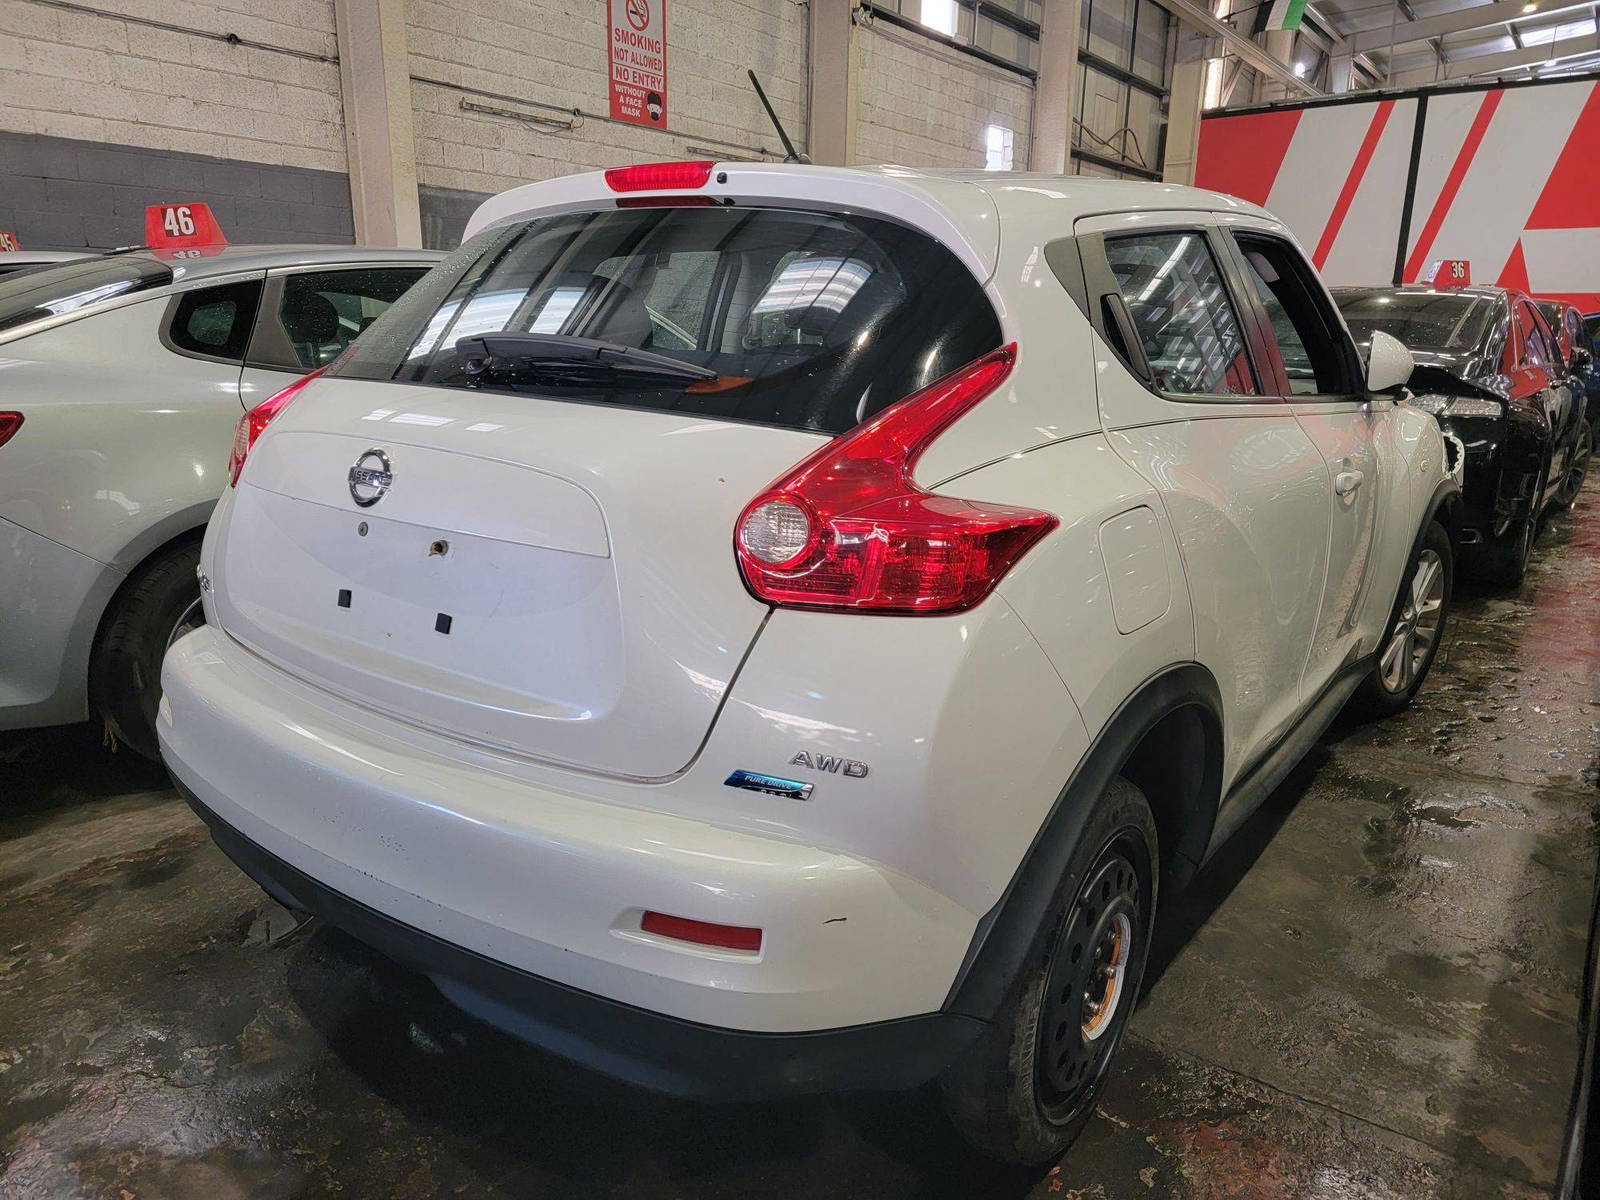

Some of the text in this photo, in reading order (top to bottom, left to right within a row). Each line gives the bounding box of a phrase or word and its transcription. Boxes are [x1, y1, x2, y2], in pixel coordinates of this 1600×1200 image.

[614, 27, 662, 54] SMOKING
[613, 46, 663, 71] NOT ALLOWED
[615, 66, 662, 90] NO ENTRY
[614, 84, 646, 98] WITHOUT
[619, 95, 643, 108] A FACE
[621, 106, 641, 117] MASK
[164, 206, 195, 237] 46
[1451, 261, 1465, 278] 36
[788, 750, 870, 779] AWD
[744, 775, 793, 790] PURE DRIVE
